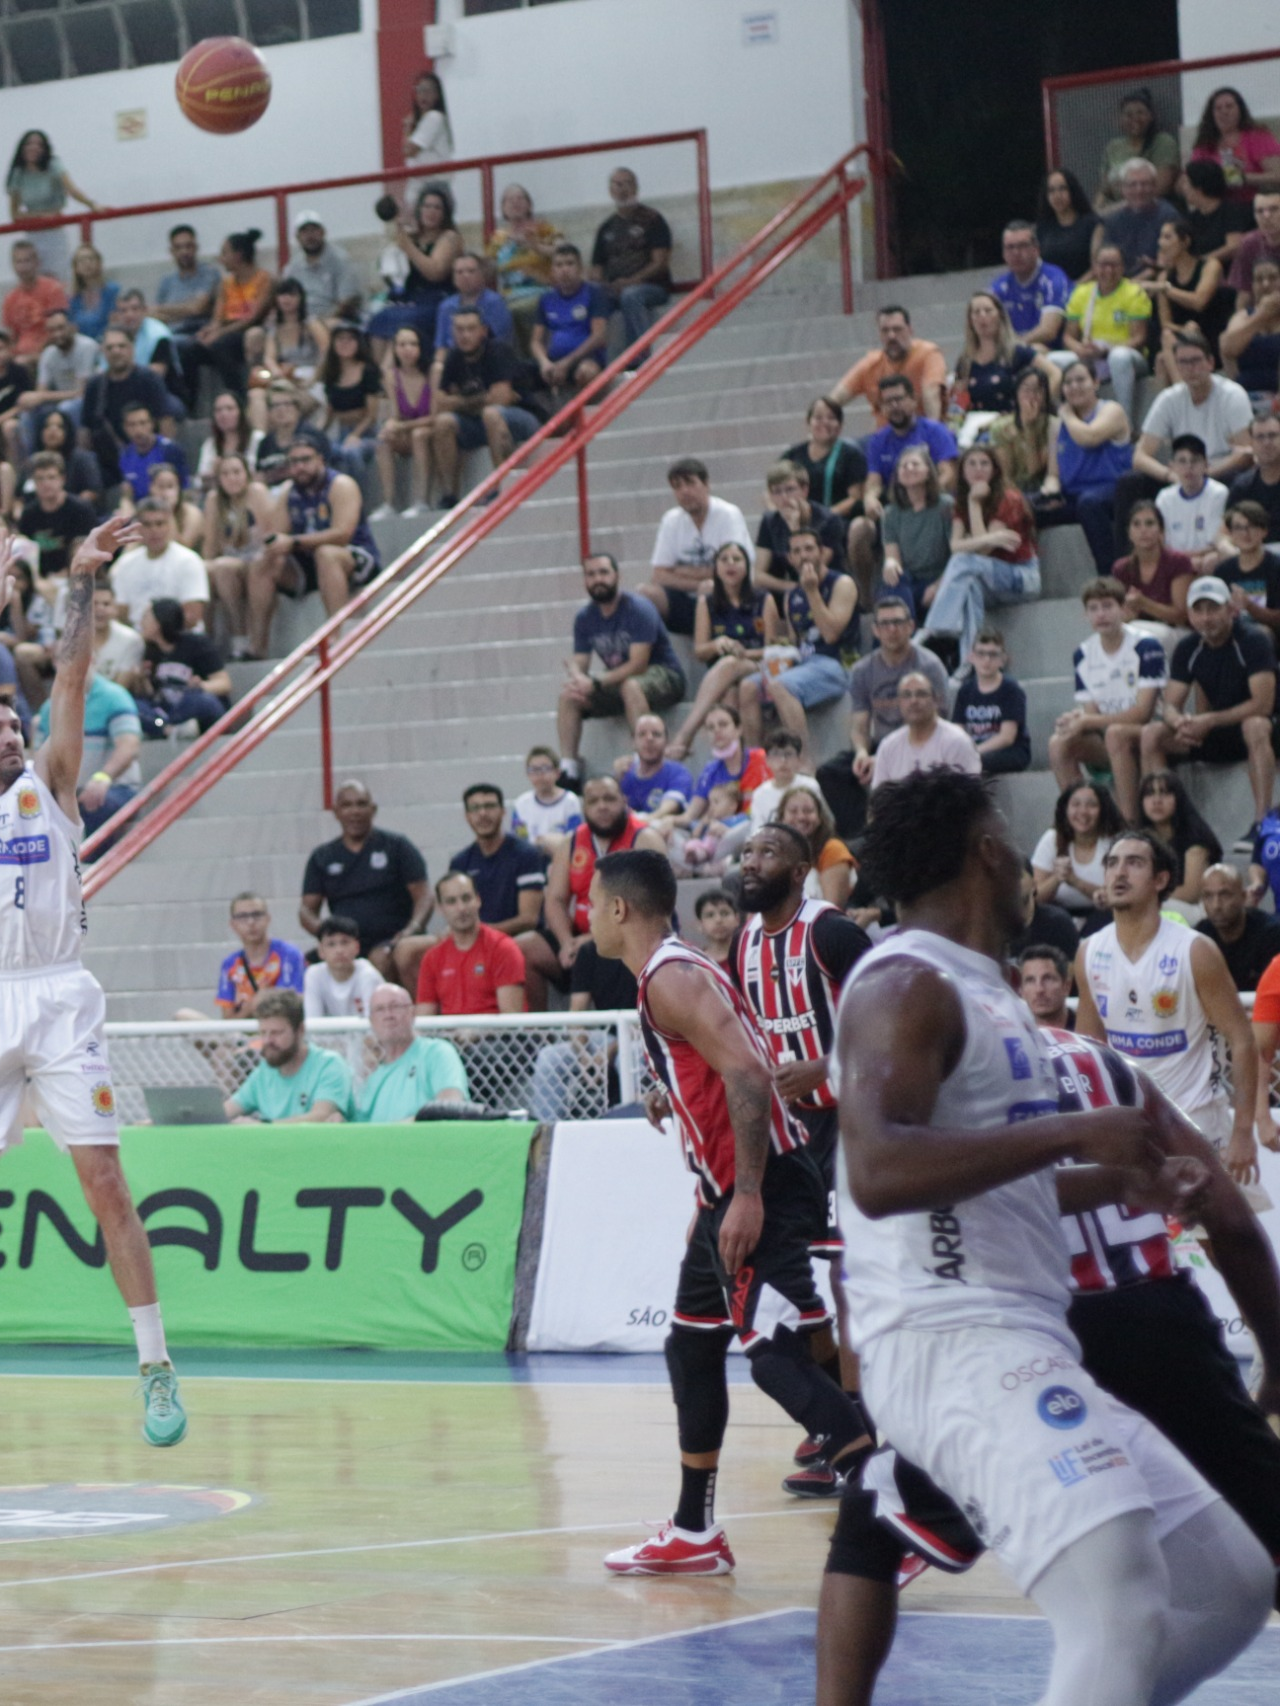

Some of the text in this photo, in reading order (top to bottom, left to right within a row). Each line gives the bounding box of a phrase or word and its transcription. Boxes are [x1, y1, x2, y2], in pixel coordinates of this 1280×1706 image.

[1136, 1034, 1183, 1049] CONDE
[626, 1305, 667, 1327] SÃO
[1047, 1394, 1081, 1415] elo
